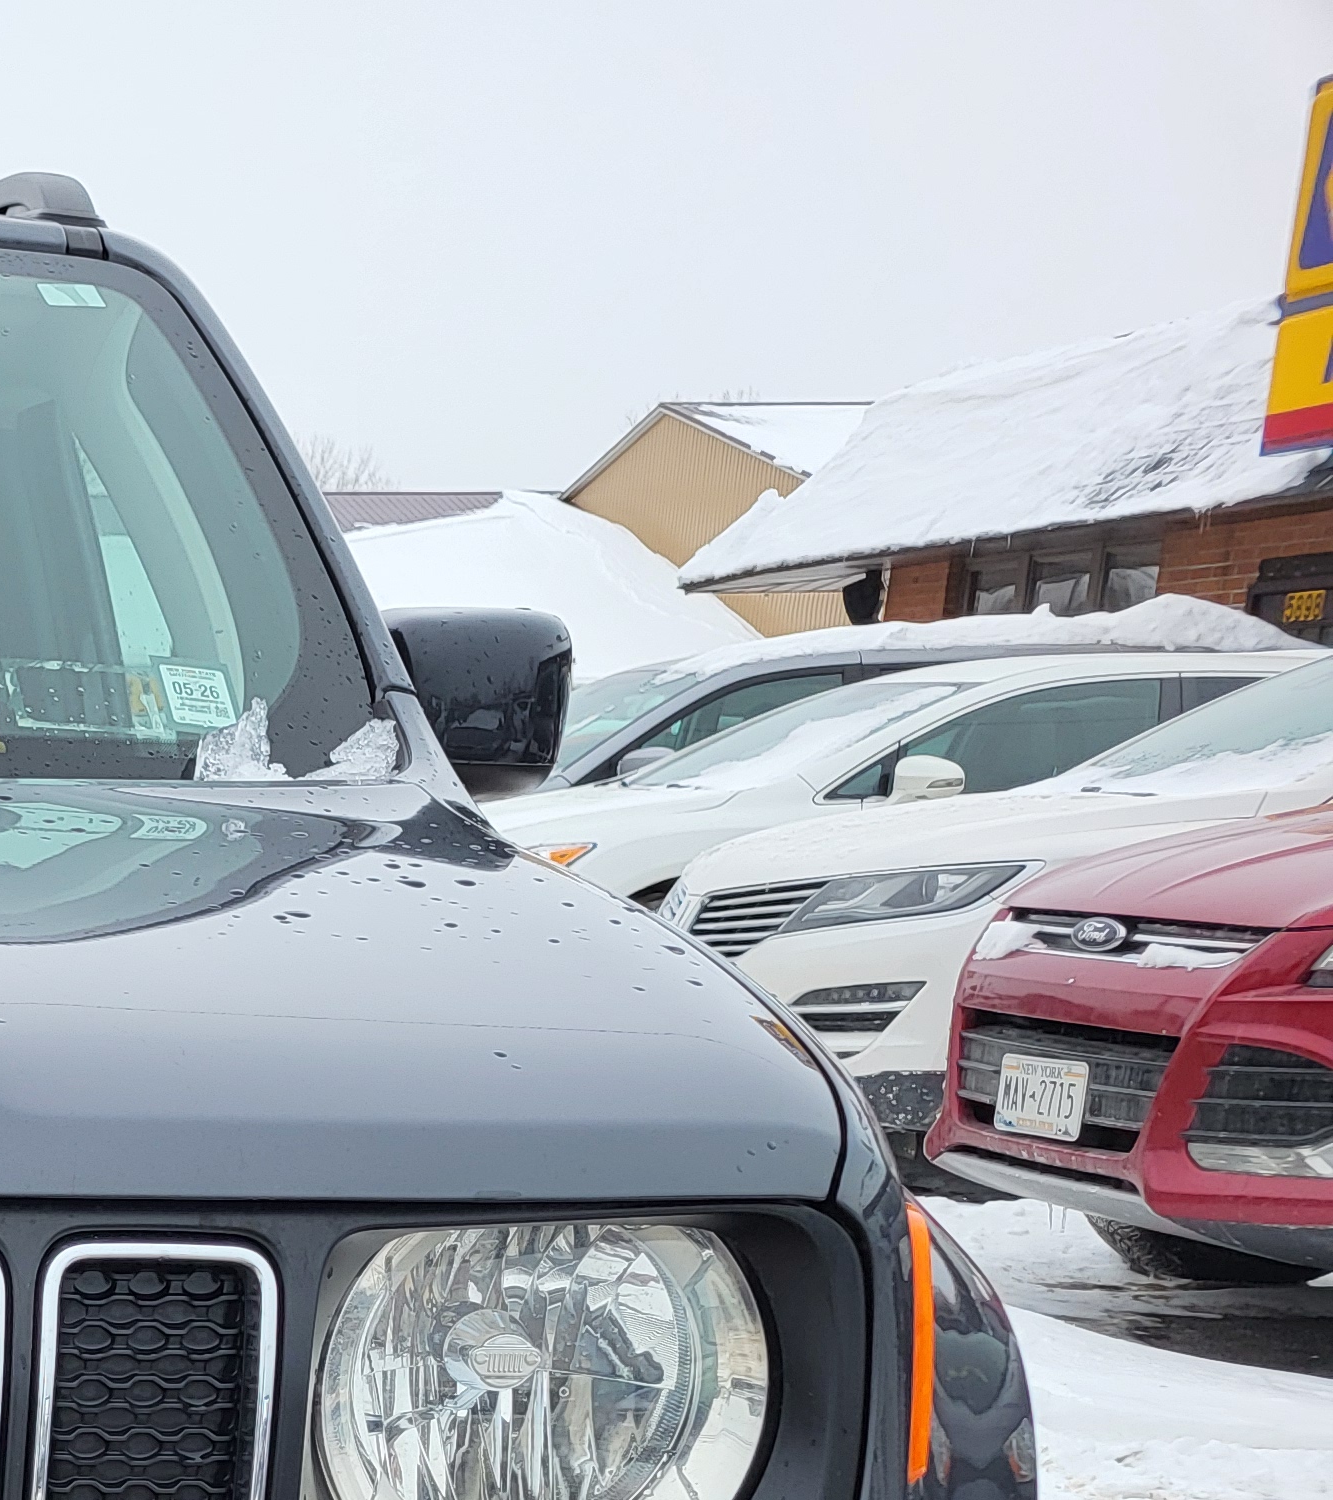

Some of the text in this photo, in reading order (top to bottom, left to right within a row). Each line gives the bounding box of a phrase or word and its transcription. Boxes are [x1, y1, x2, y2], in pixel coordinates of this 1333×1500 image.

[172, 681, 220, 699] 05-26
[1077, 921, 1111, 943] Ford
[1020, 1063, 1064, 1079] NEW YORK
[1001, 1075, 1077, 1119] MAV 2715
